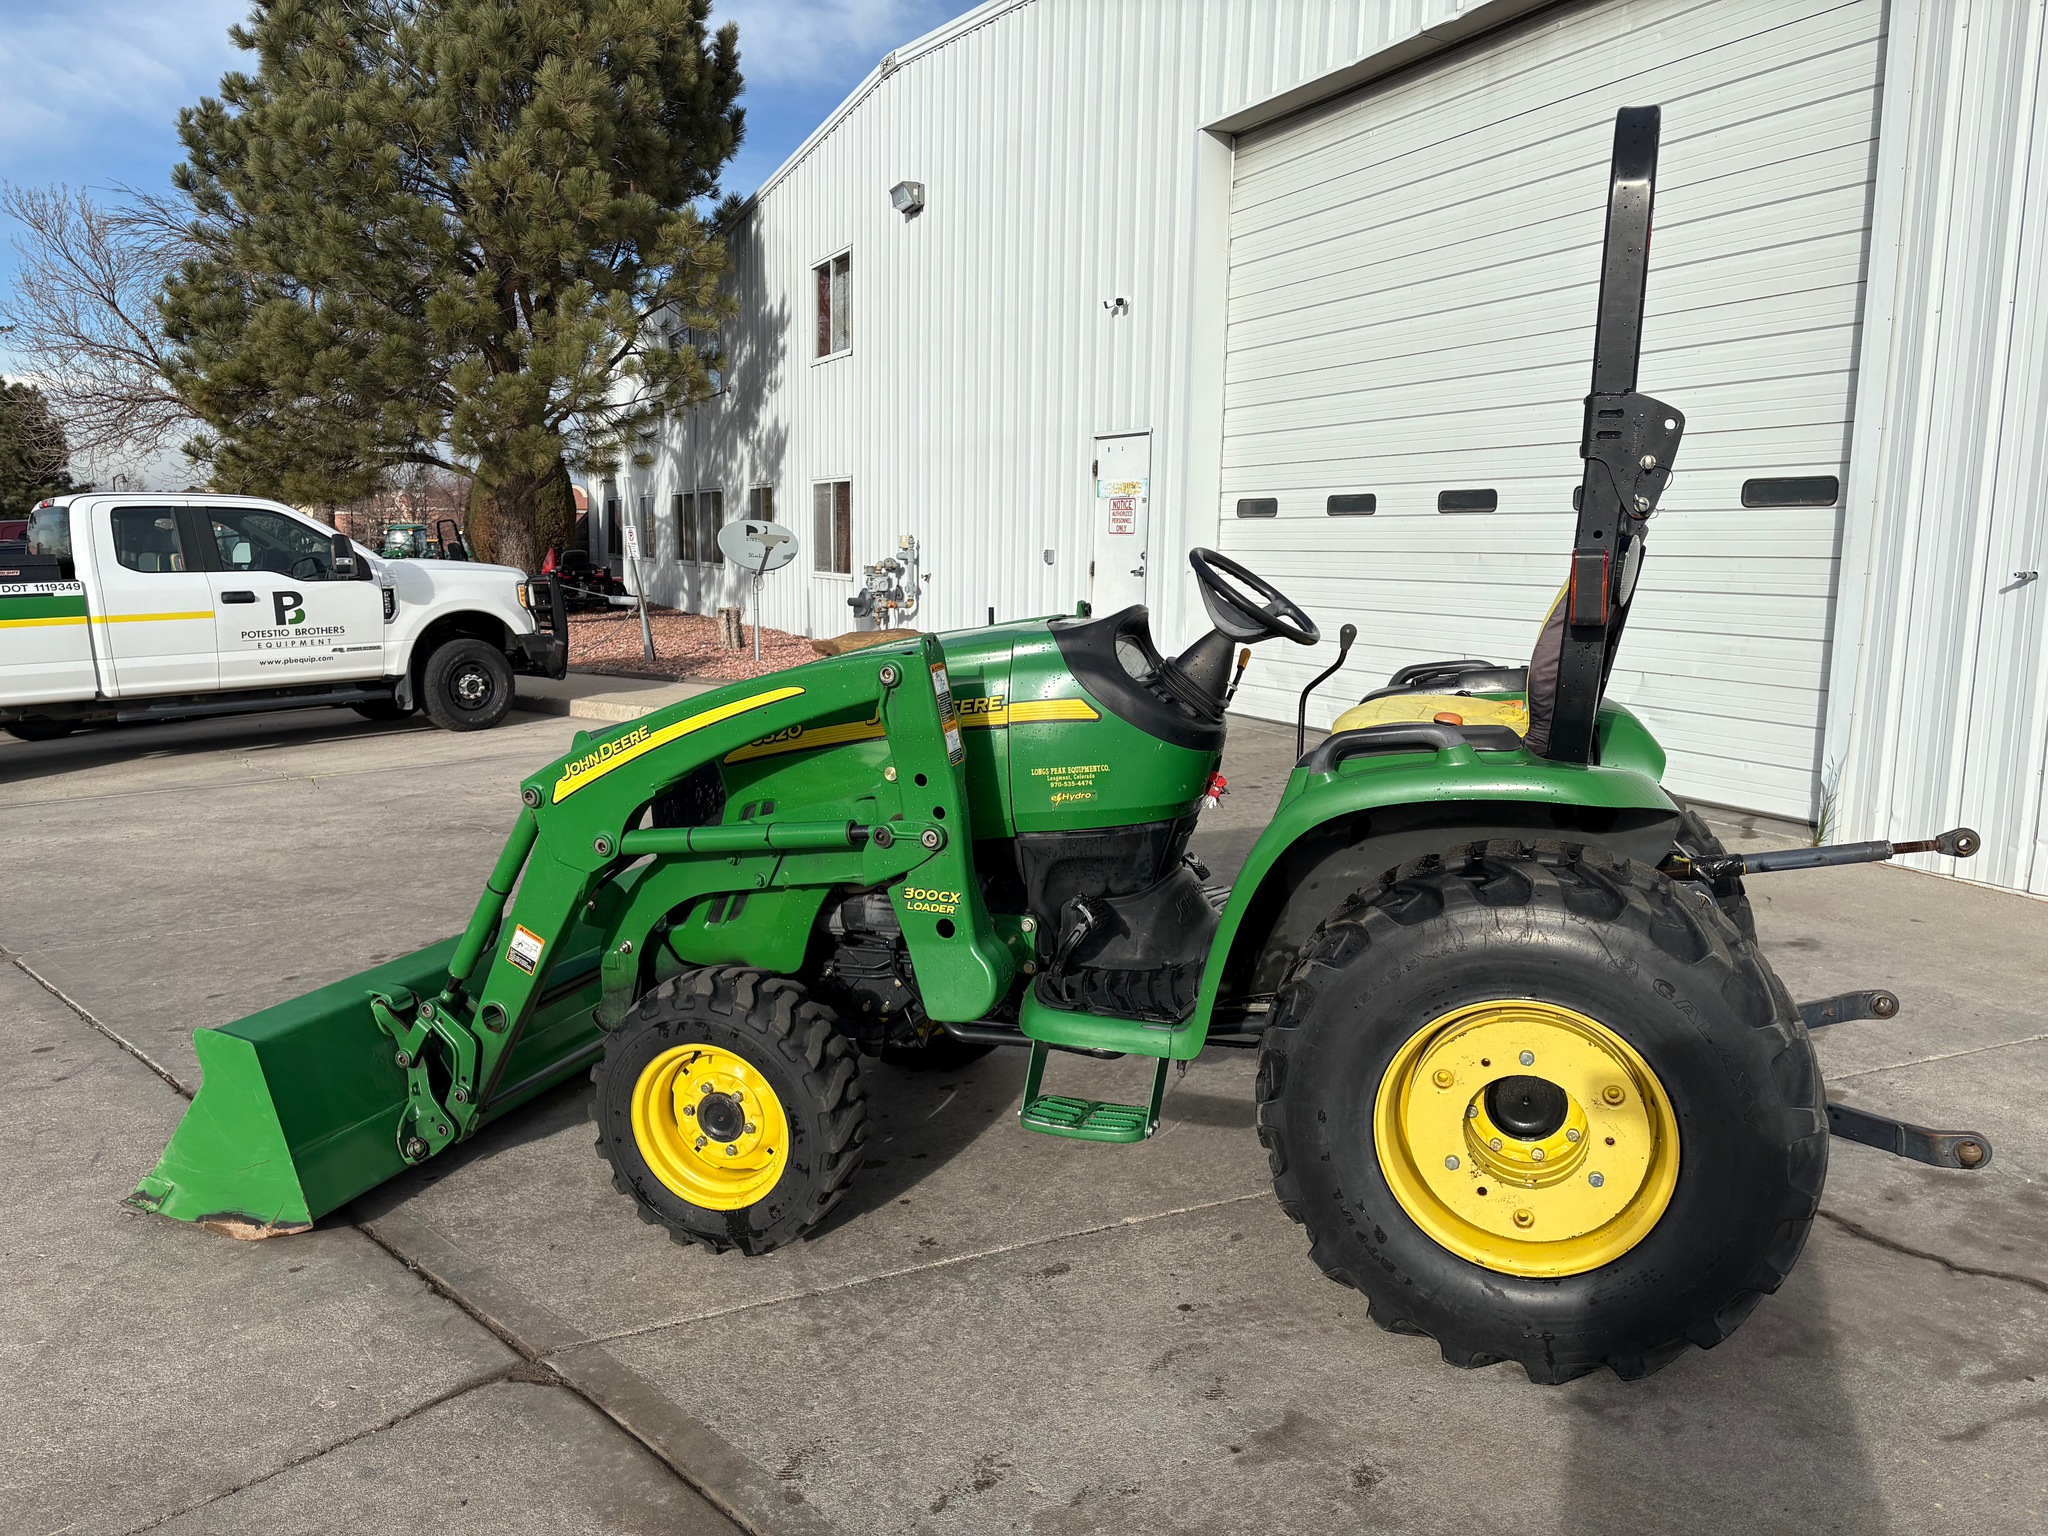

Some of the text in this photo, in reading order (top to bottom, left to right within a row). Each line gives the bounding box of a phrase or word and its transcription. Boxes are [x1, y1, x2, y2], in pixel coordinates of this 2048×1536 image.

[1112, 500, 1133, 509] NOTICE
[1, 583, 81, 593] DOT 1119349
[241, 626, 346, 639] POTESTIO BROTHERS
[257, 638, 333, 649] EQUIPMENT
[259, 655, 334, 666] www.pbequip.com
[954, 695, 1004, 715] ERE
[751, 724, 803, 746] 20
[562, 724, 652, 782] JOHN DEERE
[1031, 768, 1050, 776] LONGS
[1050, 767, 1067, 775] PEAK
[1067, 765, 1101, 774] EQUIPMENT
[903, 886, 961, 904] 300CX
[906, 901, 956, 915] LOADER
